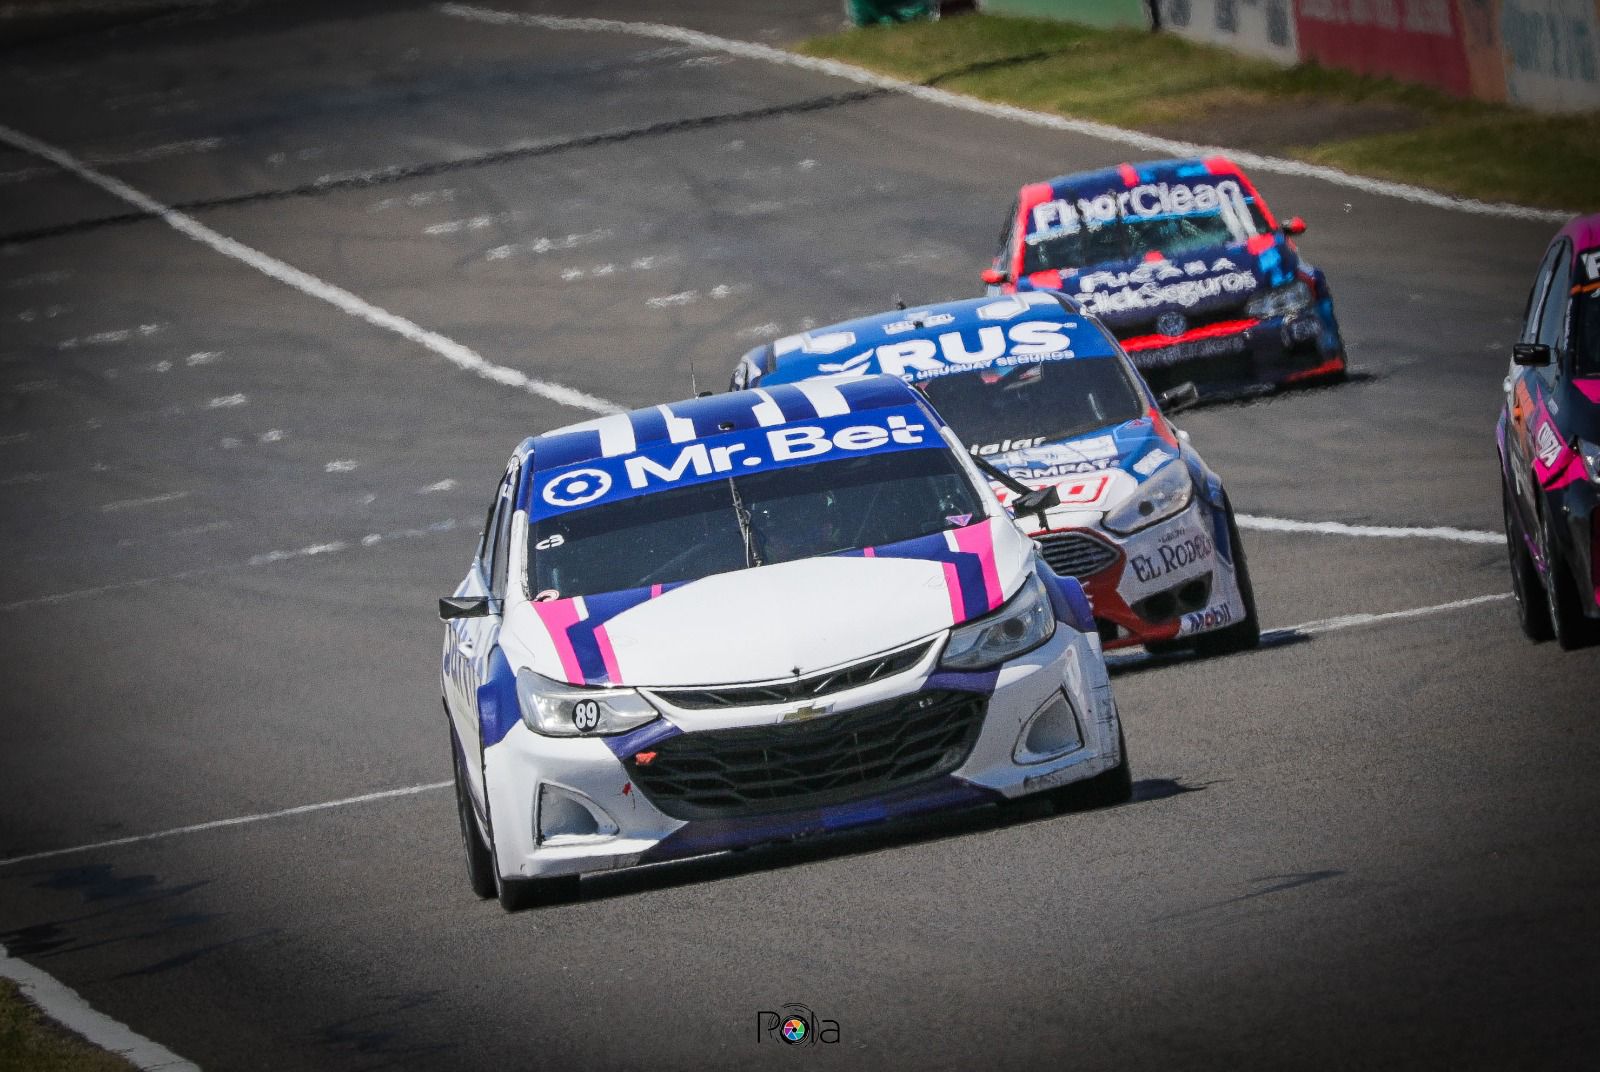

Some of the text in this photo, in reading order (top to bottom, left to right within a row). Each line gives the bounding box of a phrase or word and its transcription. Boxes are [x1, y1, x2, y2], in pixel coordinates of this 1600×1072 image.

[875, 321, 1071, 377] RUS
[917, 359, 993, 380] URUGUAY
[996, 349, 1075, 367] SEGUROS
[624, 415, 924, 489] Mr. Bet
[1130, 554, 1161, 583] EL
[1187, 602, 1232, 633] Mobil
[575, 703, 598, 730] 89
